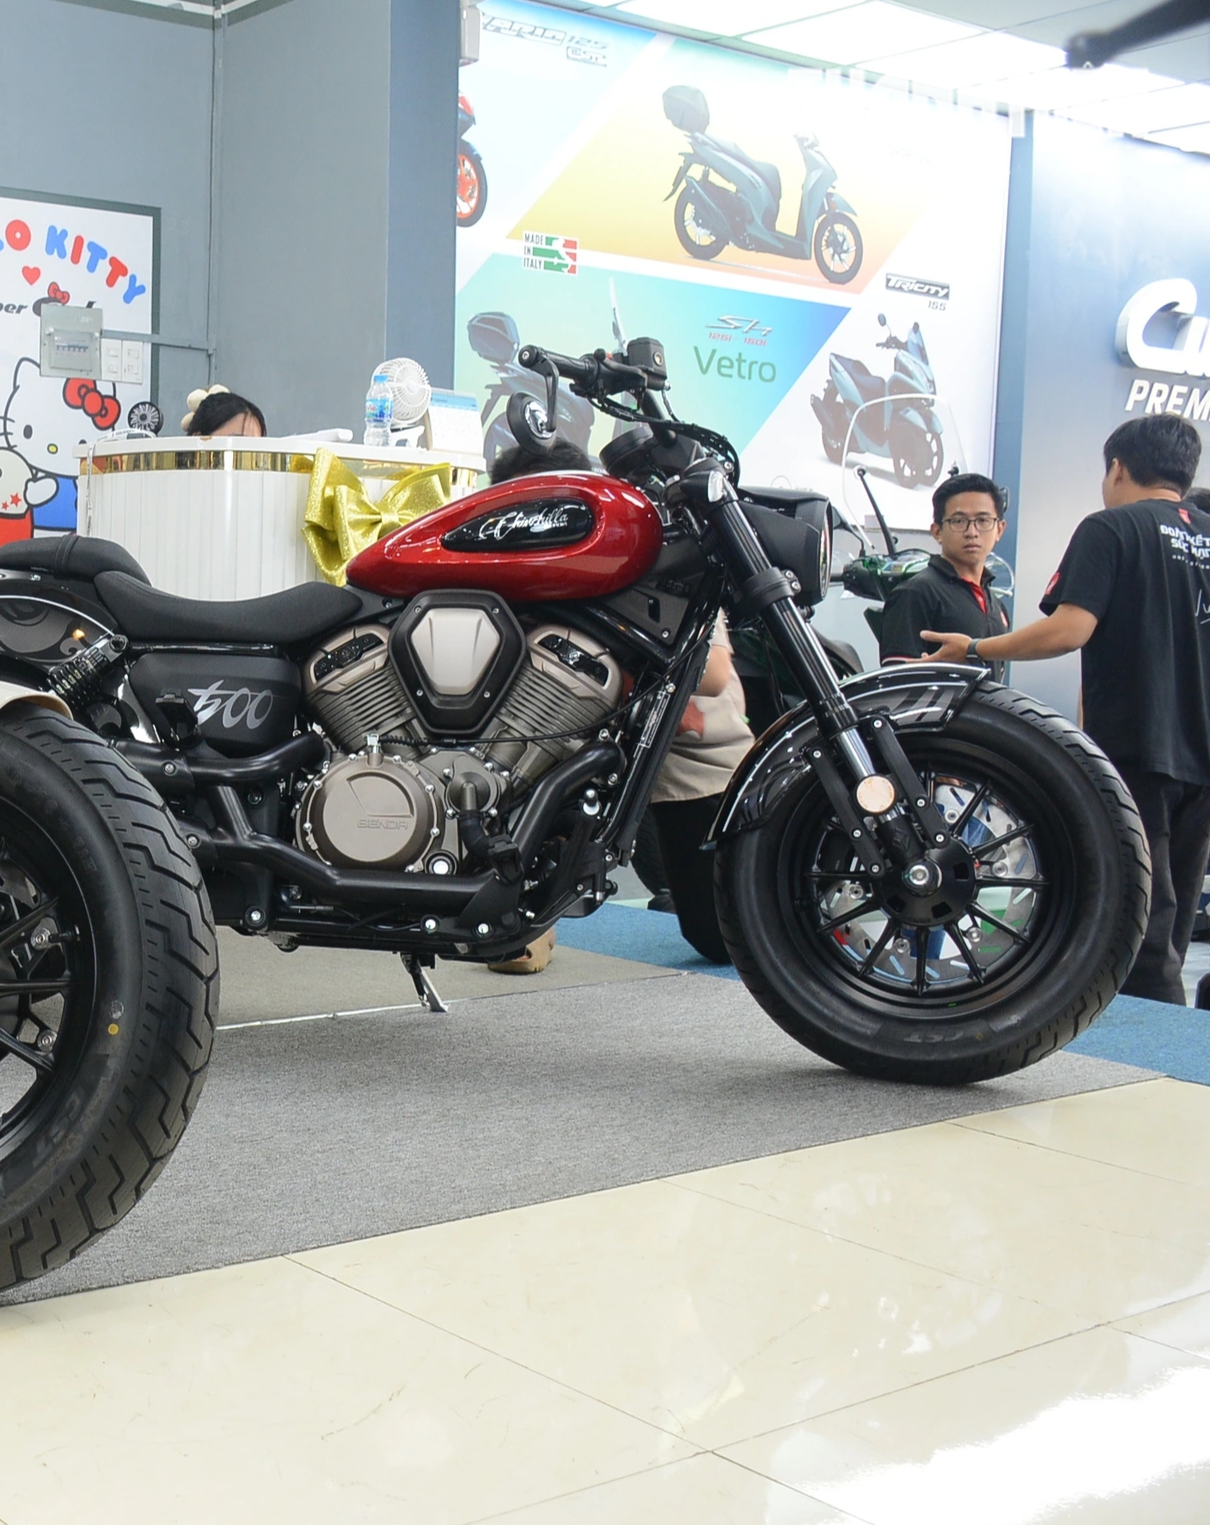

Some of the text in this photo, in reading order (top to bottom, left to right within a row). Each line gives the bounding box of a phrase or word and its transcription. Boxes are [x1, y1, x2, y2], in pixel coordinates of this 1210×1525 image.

[524, 233, 543, 246] MADE
[523, 245, 531, 256] IN
[45, 225, 146, 304] KITTY
[523, 257, 542, 270] ITALY
[928, 300, 947, 311] 155
[693, 345, 777, 383] Vetro
[187, 679, 274, 730] 500
[357, 819, 409, 831] BENDA
